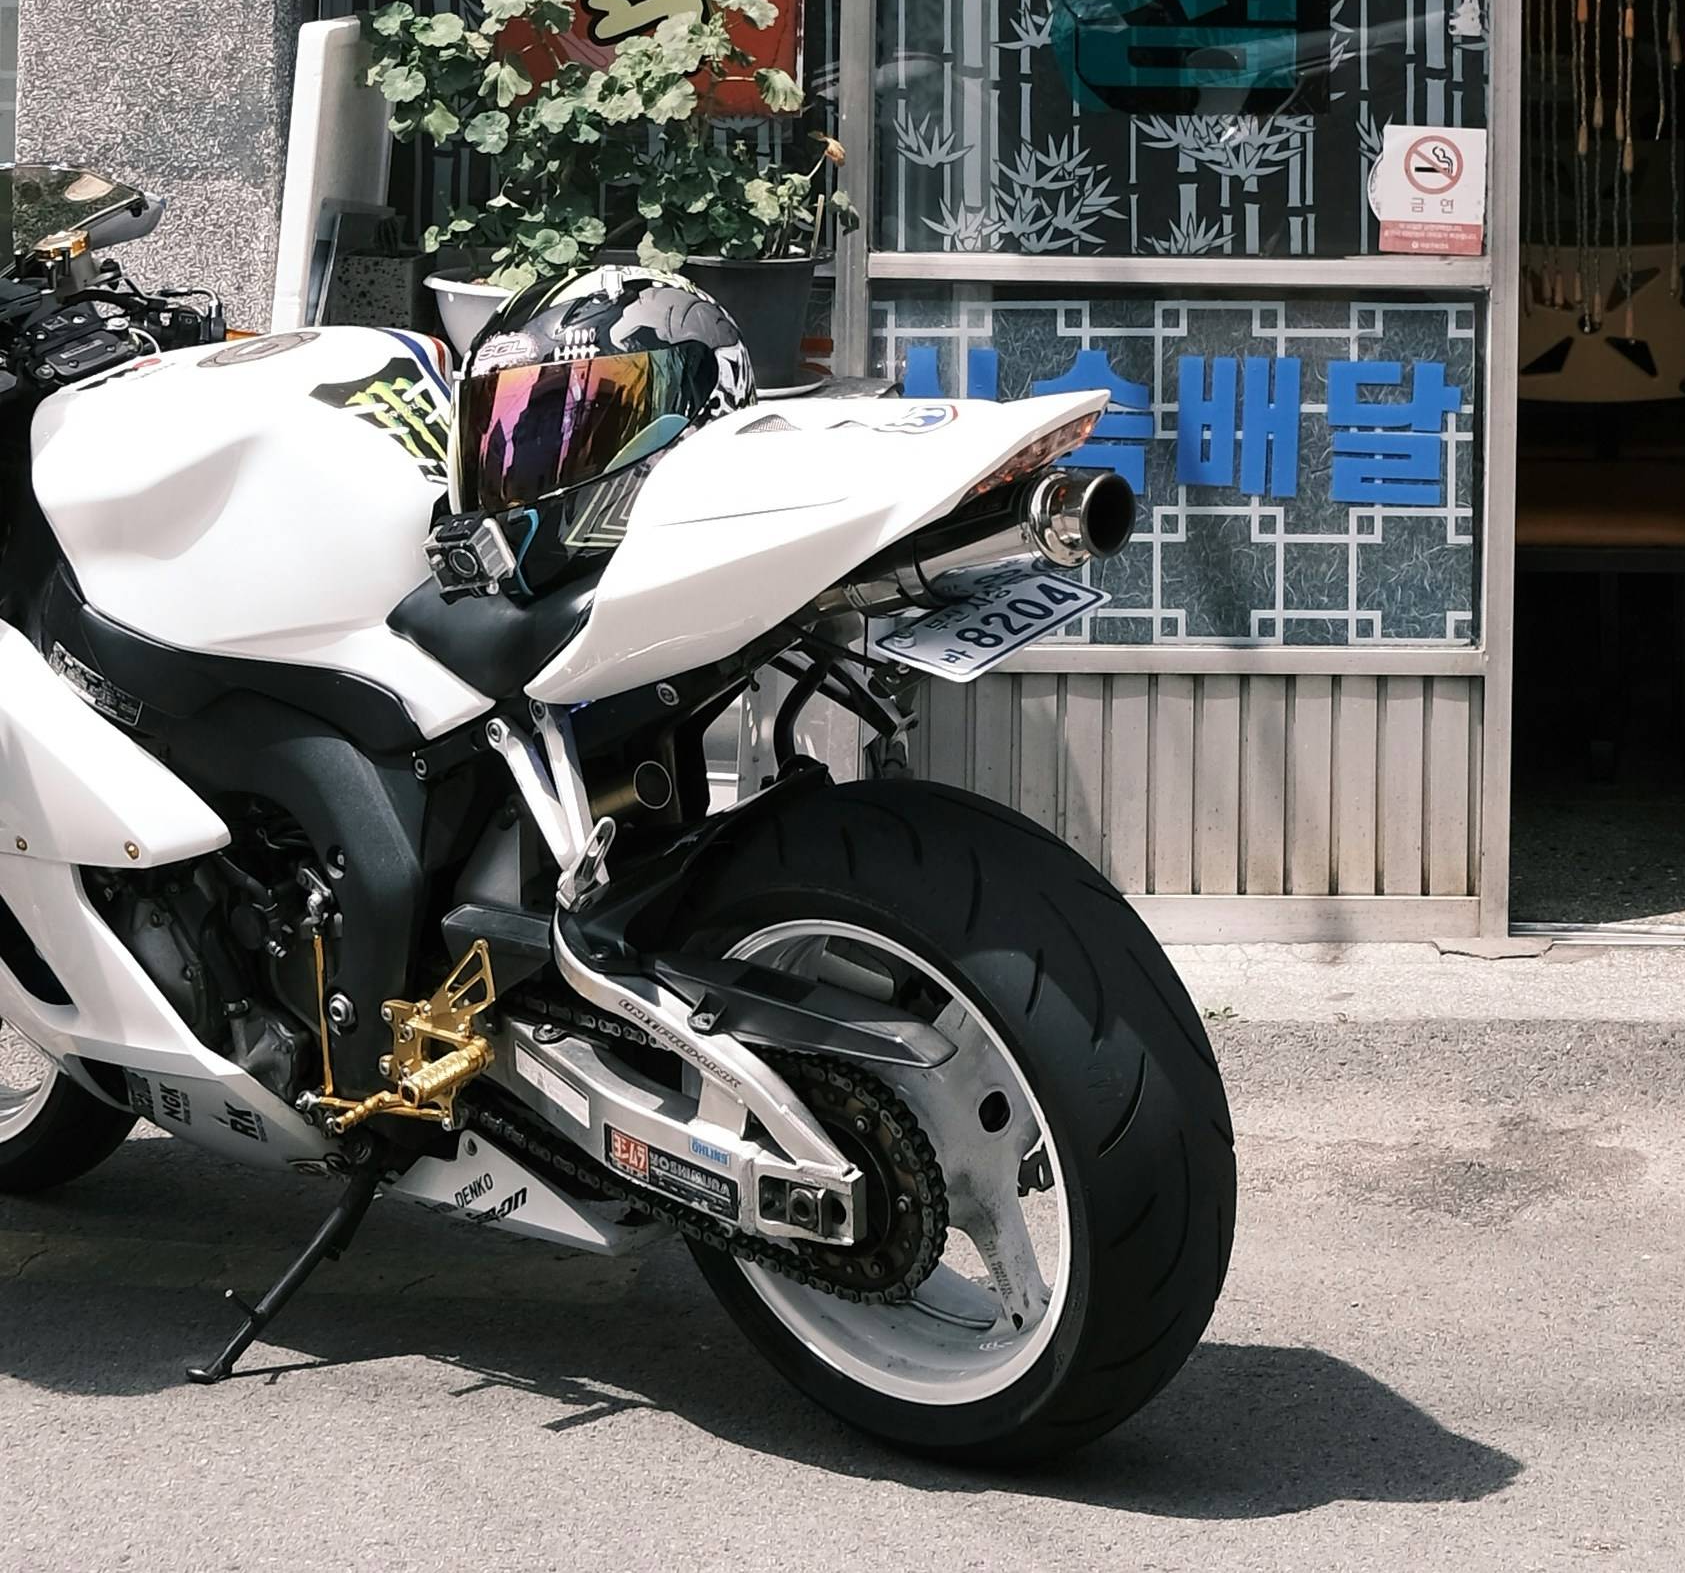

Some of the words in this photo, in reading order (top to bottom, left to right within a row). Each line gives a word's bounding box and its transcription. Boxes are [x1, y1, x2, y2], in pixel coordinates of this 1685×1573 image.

[903, 347, 1462, 505] 속배달
[955, 583, 1082, 649] 8204
[160, 1082, 184, 1122] NGK
